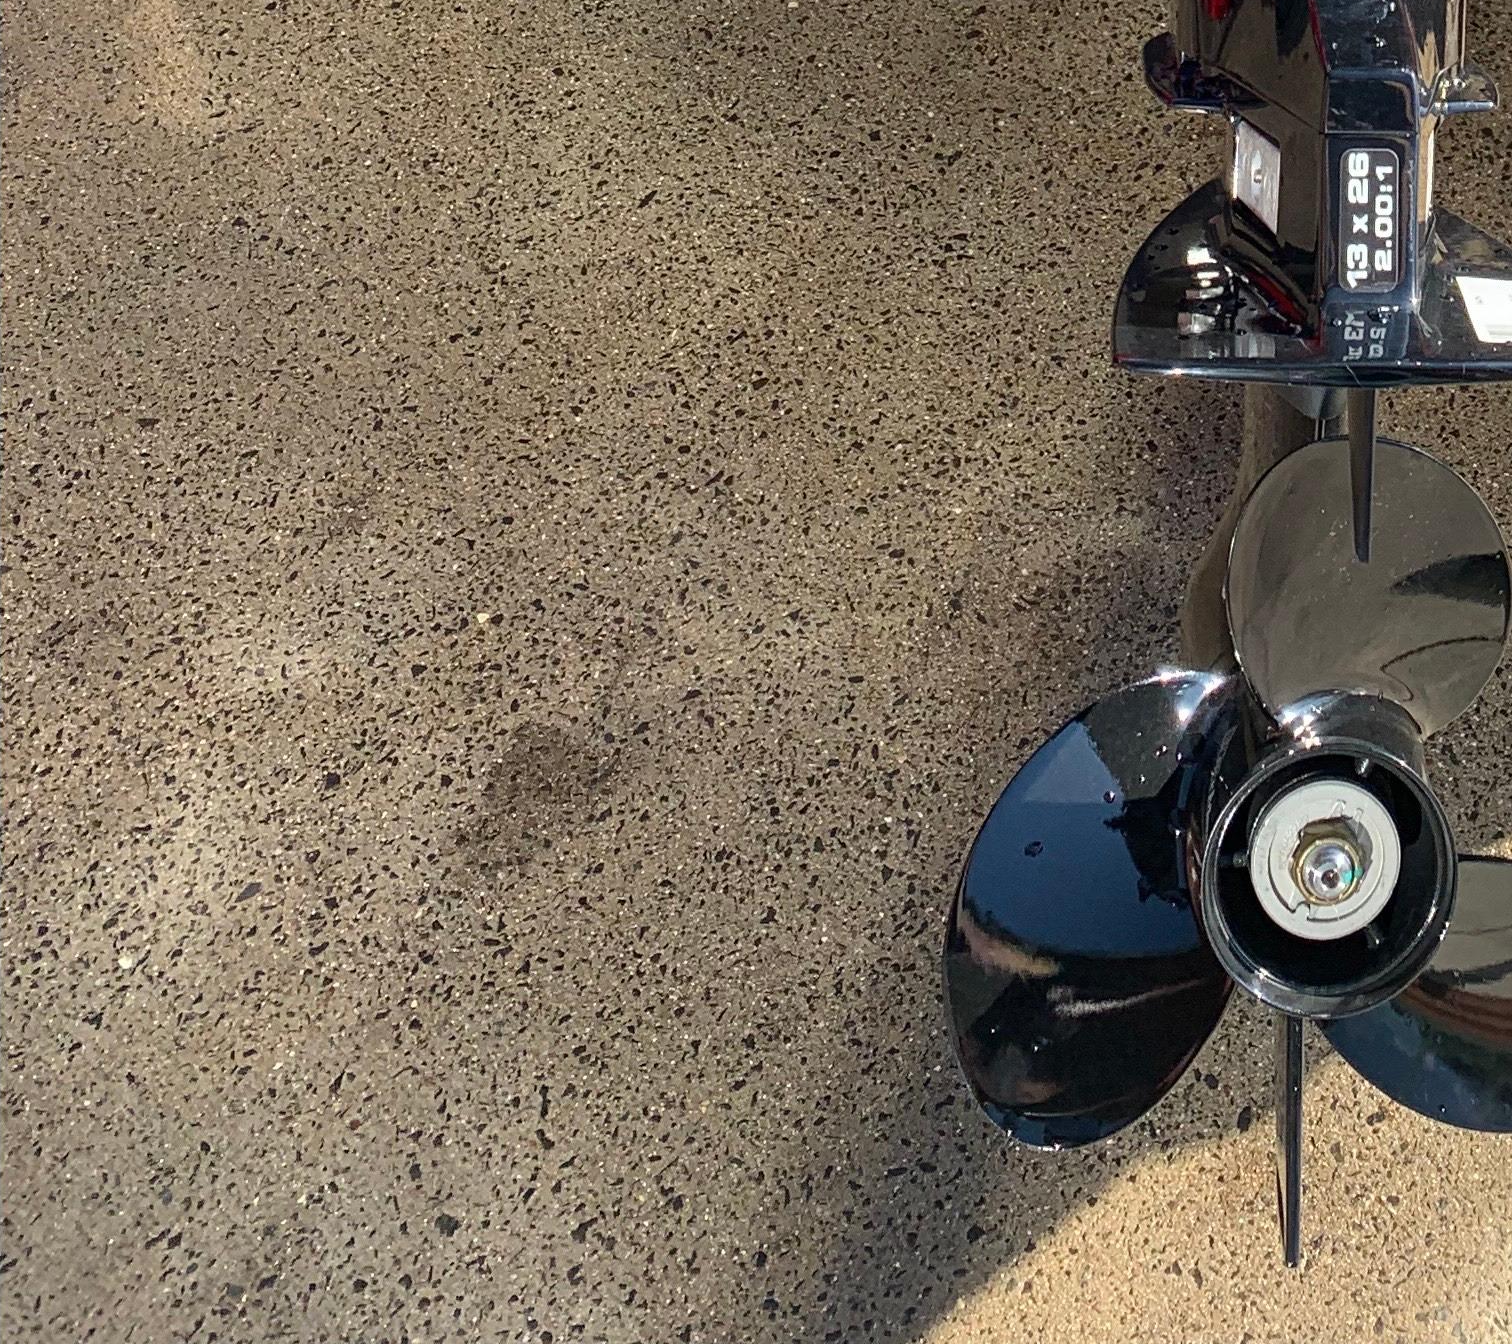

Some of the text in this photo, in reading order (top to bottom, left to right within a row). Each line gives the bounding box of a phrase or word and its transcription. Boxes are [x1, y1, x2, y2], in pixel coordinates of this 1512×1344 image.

[1348, 152, 1369, 204] 26
[1375, 165, 1393, 272] 2.00:1
[1346, 243, 1369, 289] 13
